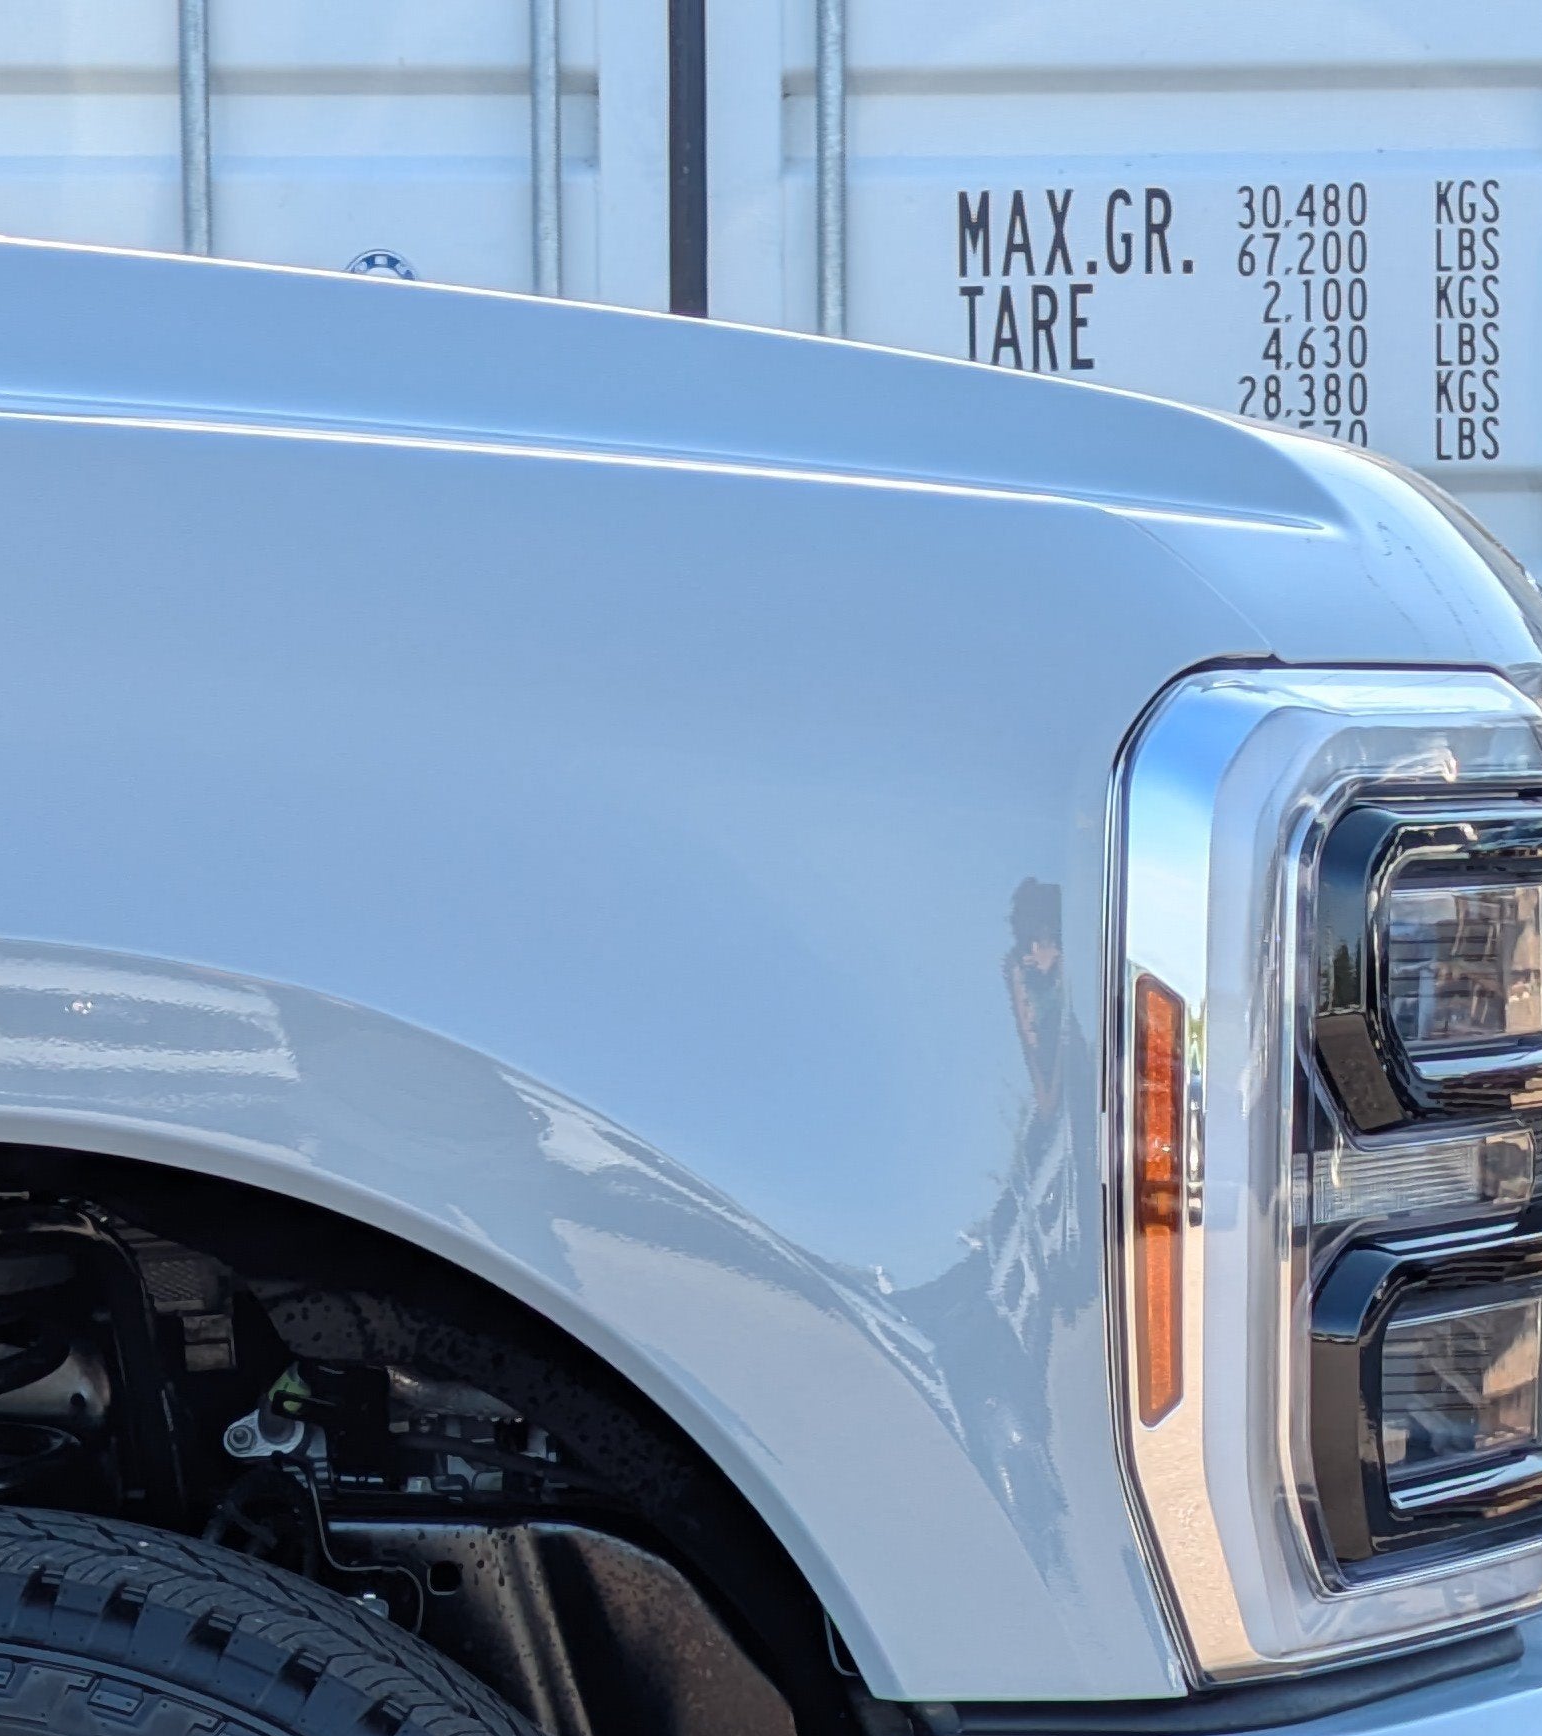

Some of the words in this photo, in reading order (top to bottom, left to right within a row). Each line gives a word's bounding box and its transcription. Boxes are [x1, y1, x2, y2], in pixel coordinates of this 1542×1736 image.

[958, 187, 1194, 277] MAX.GR.
[1436, 179, 1500, 224] KGS
[1436, 227, 1500, 272] LBS
[960, 284, 1095, 372] TARE
[1436, 274, 1500, 319] KGS
[1436, 321, 1500, 367] LBS
[1436, 369, 1500, 414] KGS
[1436, 416, 1500, 461] LBS
